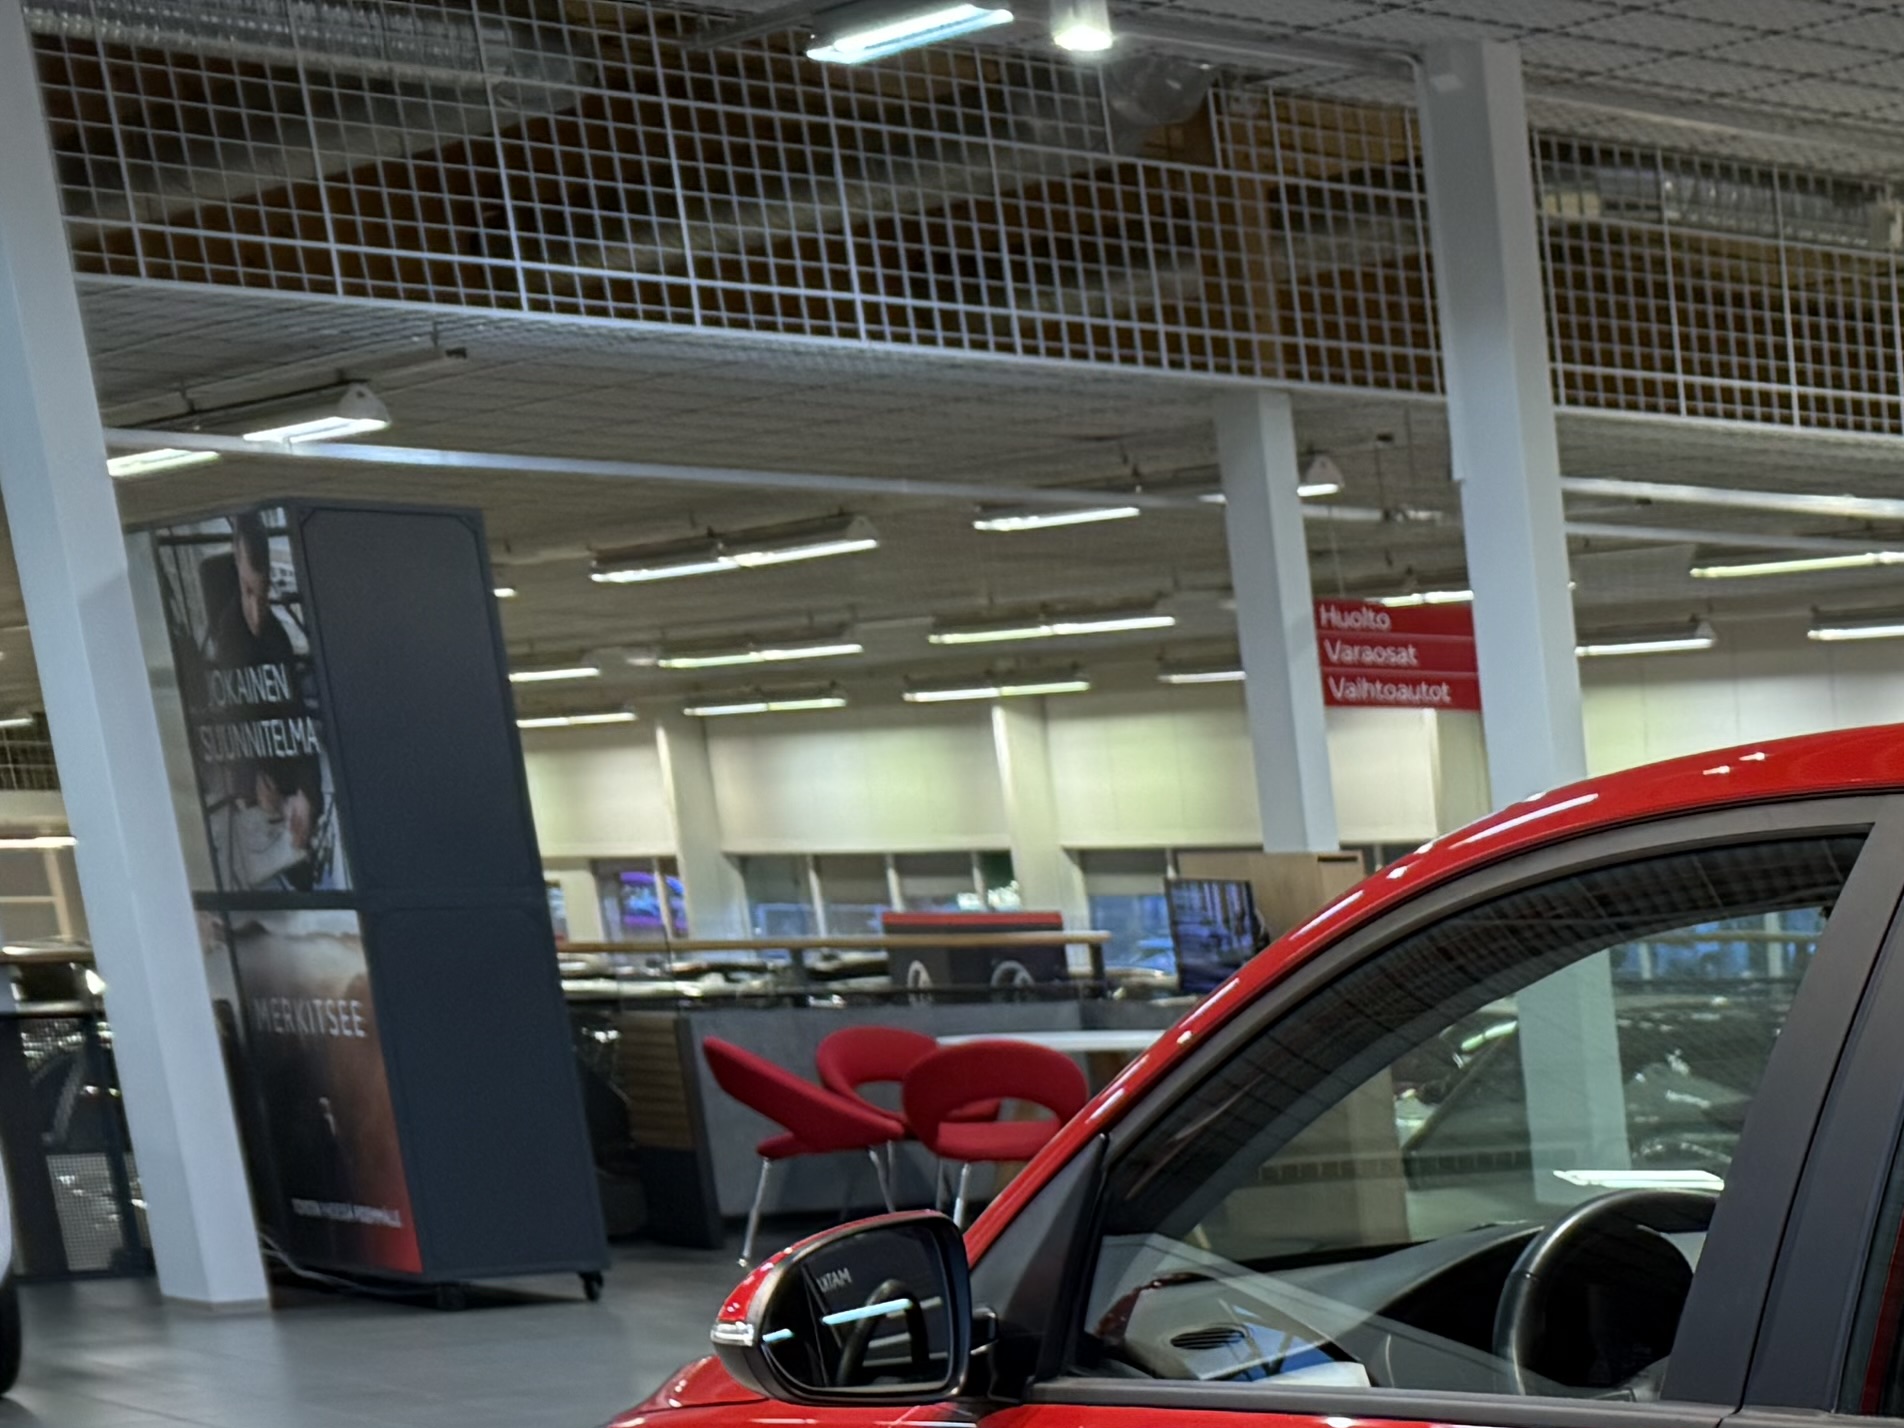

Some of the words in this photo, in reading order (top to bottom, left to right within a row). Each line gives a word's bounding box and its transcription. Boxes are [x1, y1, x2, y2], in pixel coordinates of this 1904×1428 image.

[1320, 604, 1391, 630] Huolto
[1323, 639, 1418, 666] Varaosat
[1328, 675, 1451, 704] Vaihtoautot
[254, 996, 367, 1039] MERKITSEE
